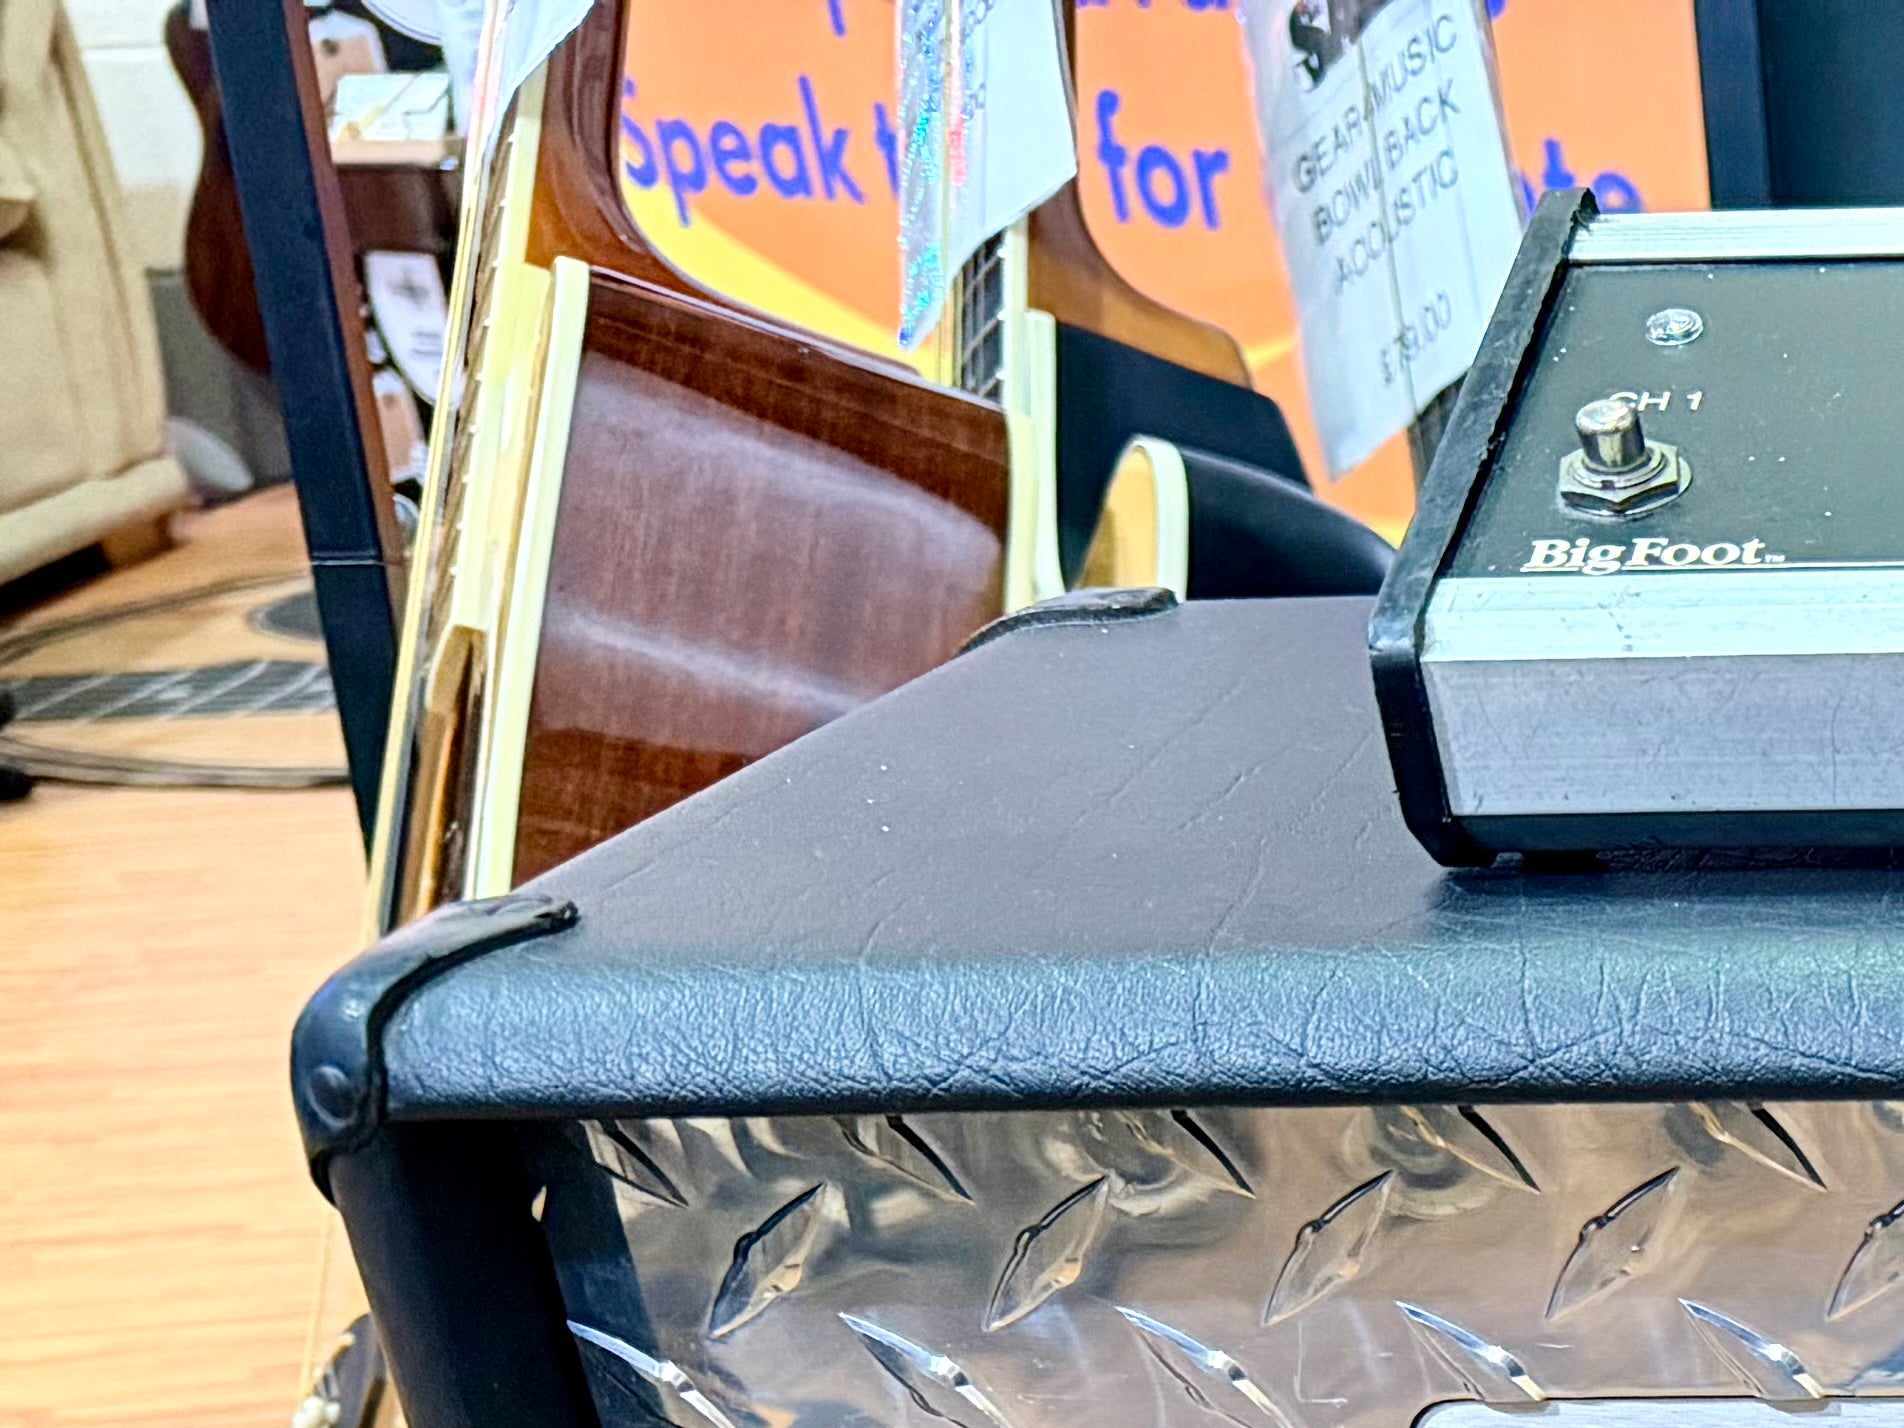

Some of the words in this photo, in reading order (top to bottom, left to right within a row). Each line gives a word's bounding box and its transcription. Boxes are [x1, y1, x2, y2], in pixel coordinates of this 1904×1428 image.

[1096, 89, 1229, 230] for
[1383, 77, 1462, 172] BACK
[1333, 149, 1460, 297] ACOUSTIC
[1686, 391, 1703, 411] 1
